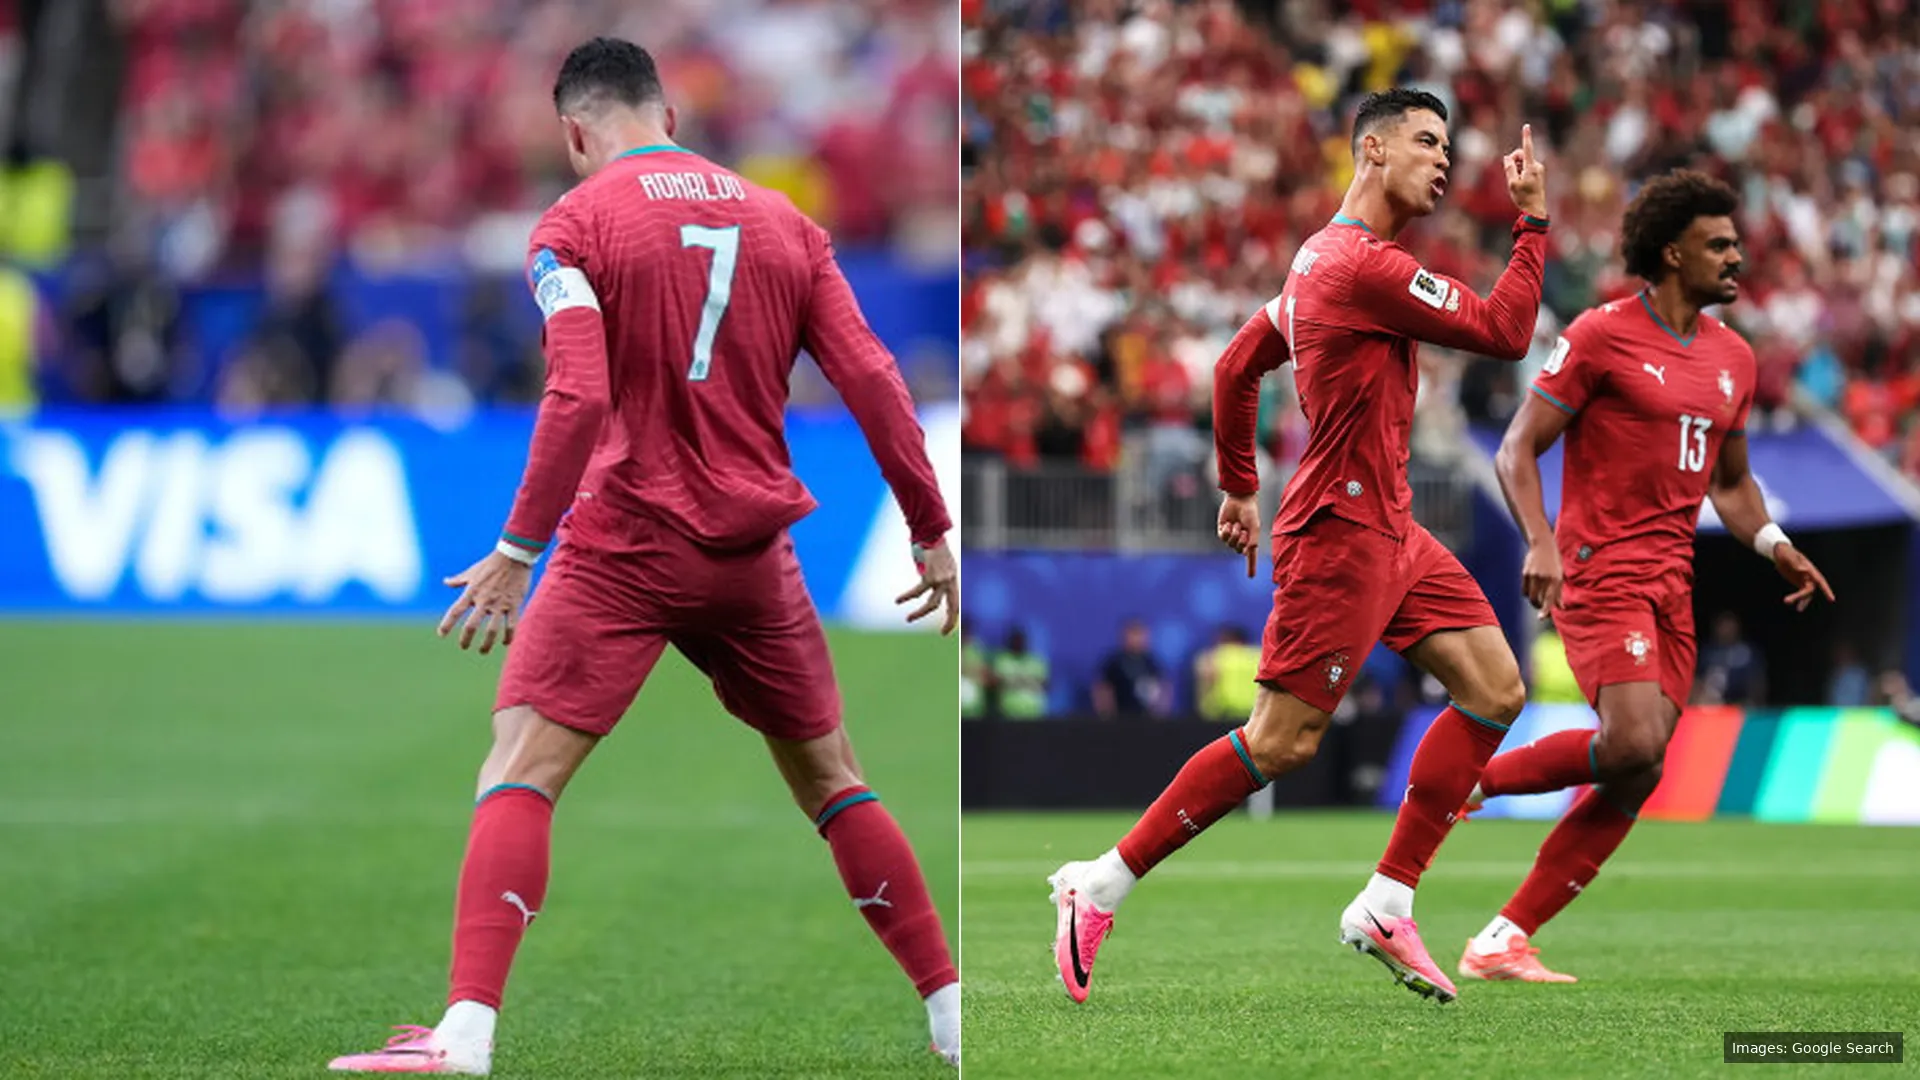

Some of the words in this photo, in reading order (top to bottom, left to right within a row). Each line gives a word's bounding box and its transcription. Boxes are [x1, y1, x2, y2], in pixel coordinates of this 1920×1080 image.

[637, 171, 747, 202] RONALDO
[679, 224, 741, 382] 7
[1678, 413, 1713, 472] 13
[10, 427, 426, 601] VISA
